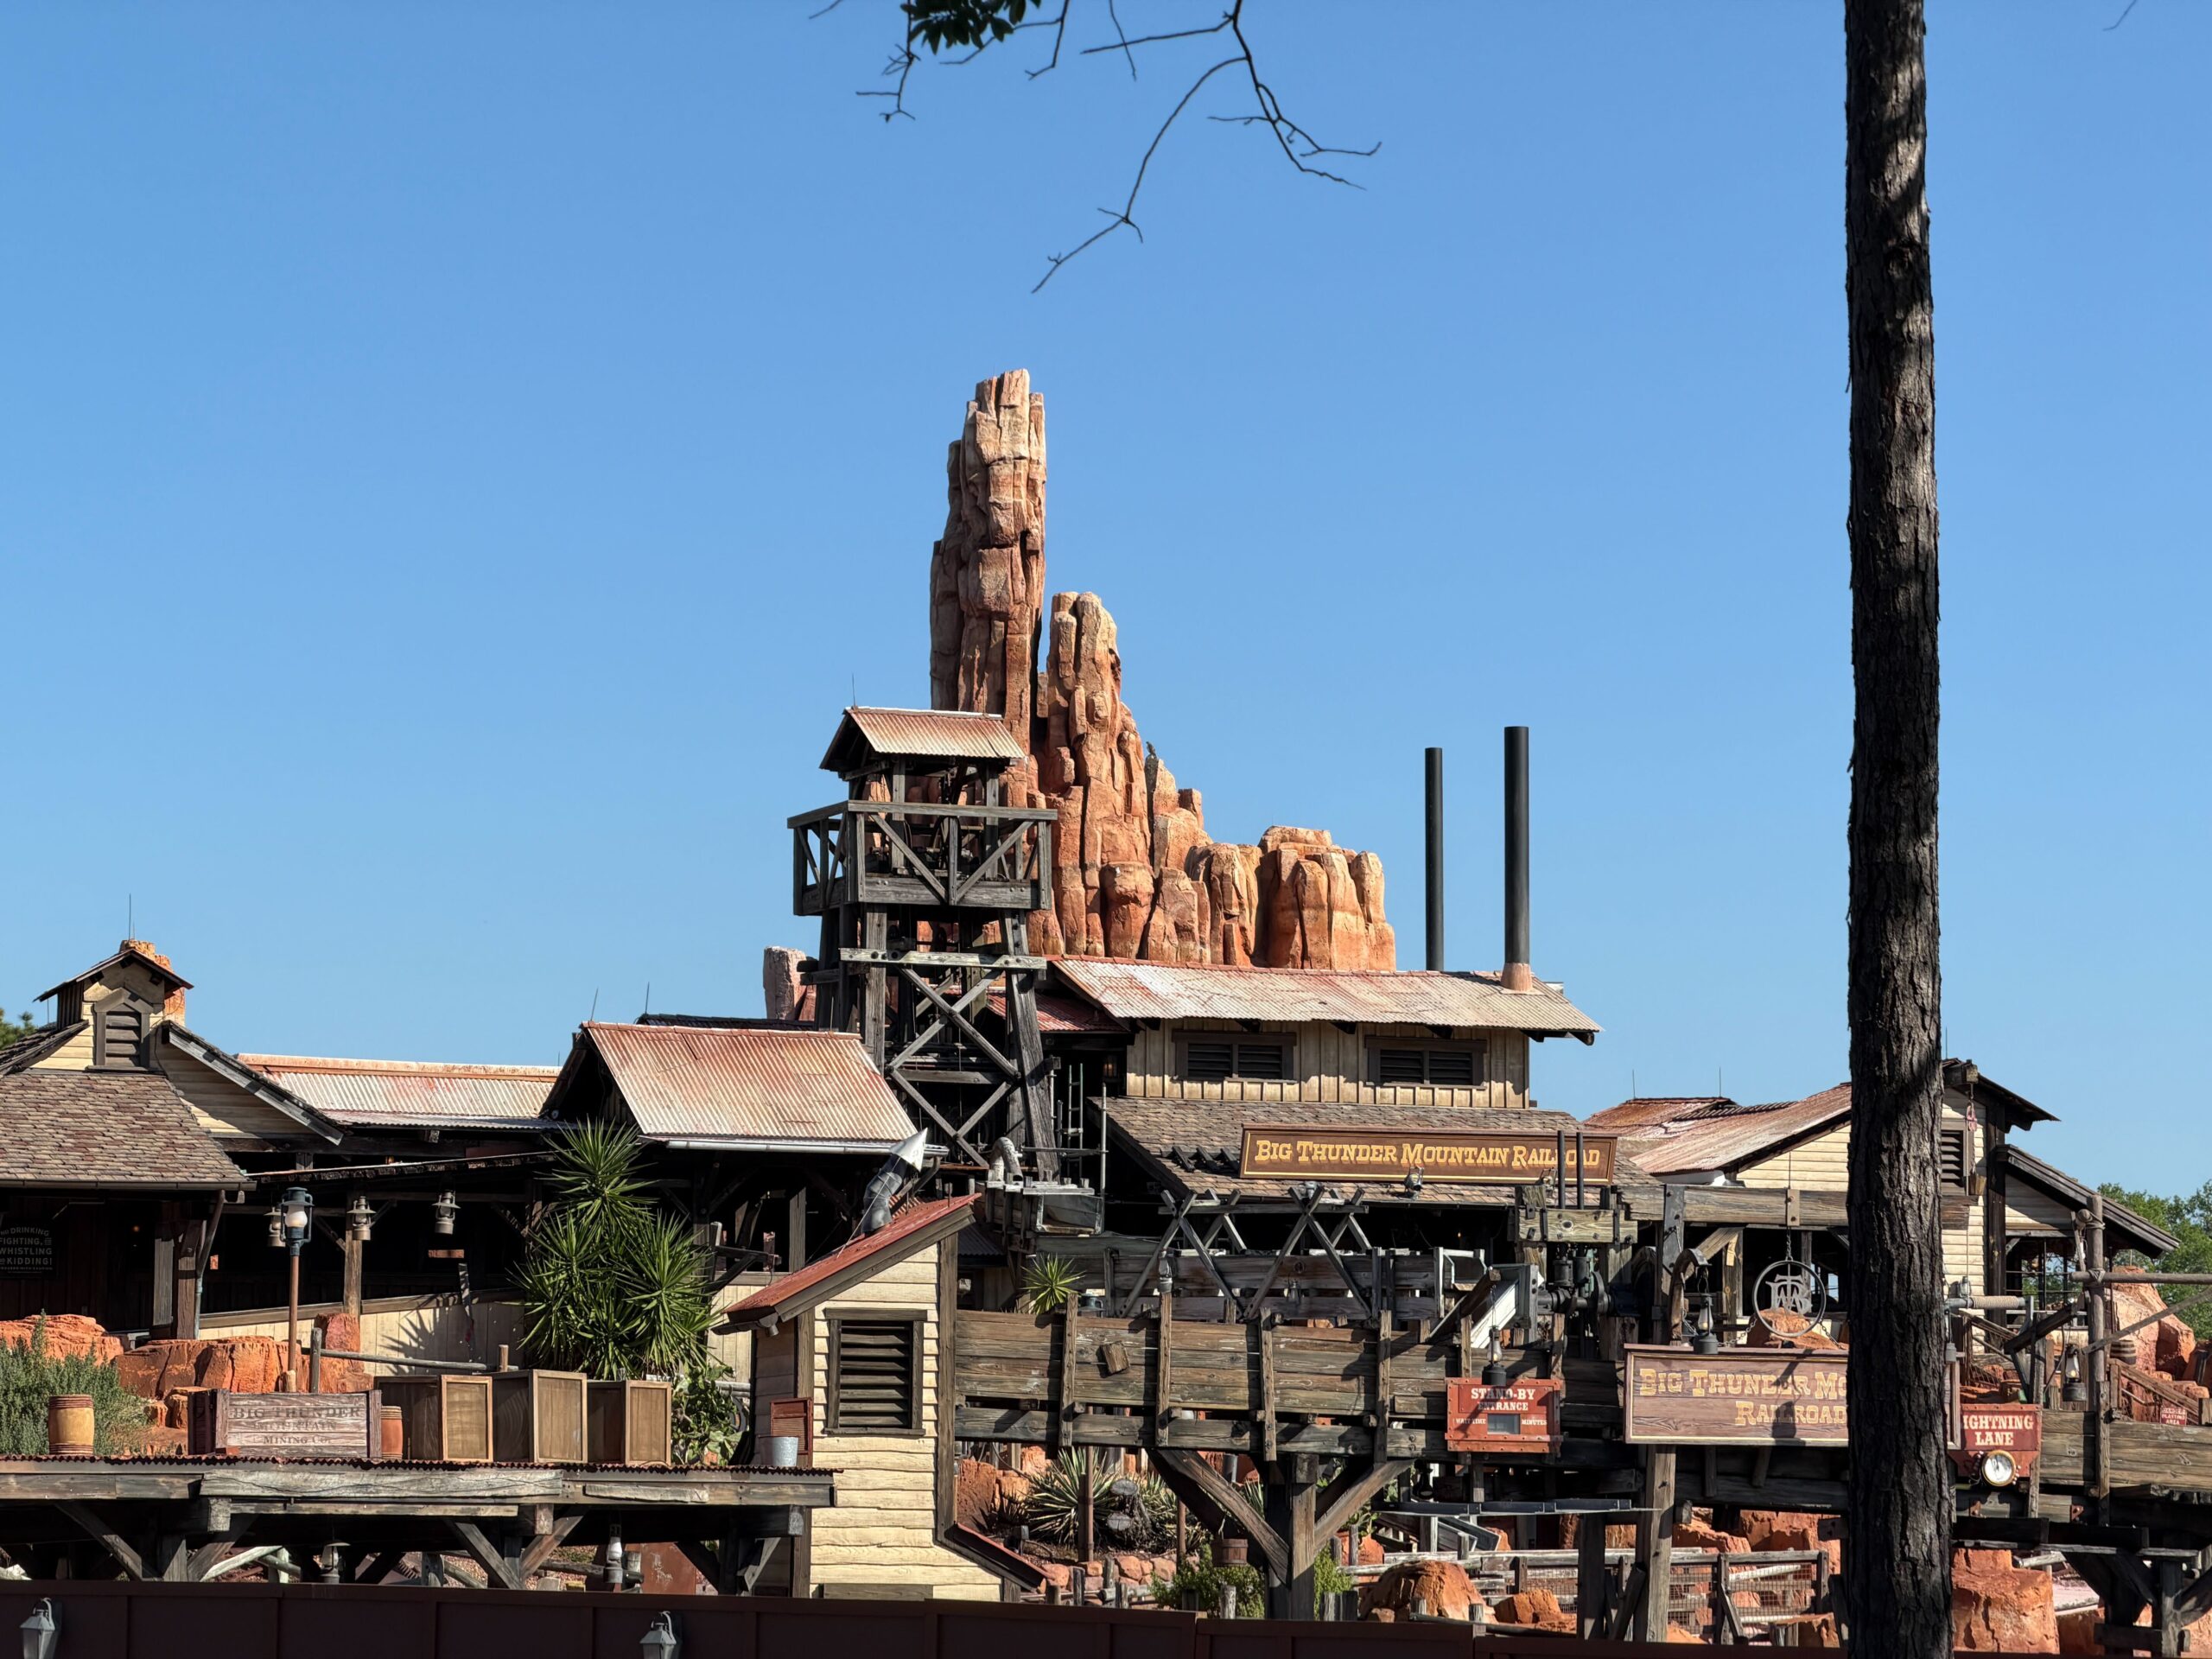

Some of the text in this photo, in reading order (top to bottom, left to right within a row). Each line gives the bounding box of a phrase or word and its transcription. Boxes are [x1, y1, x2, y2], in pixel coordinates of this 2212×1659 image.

[1255, 1140, 1600, 1167] BIG THUNDER MOUNTAIN RAILOD
[10, 1227, 49, 1236] DRINKING
[1639, 1368, 1683, 1396] BIG
[1689, 1370, 1811, 1397] THUNDER
[1471, 1388, 1535, 1400] STAND-BY
[233, 1408, 265, 1419] BIG
[1478, 1402, 1529, 1411] ENTRANCE
[1735, 1401, 1847, 1426] RAILROAD
[1963, 1414, 2034, 1430] IGHTNING
[1974, 1431, 2014, 1446] LANE
